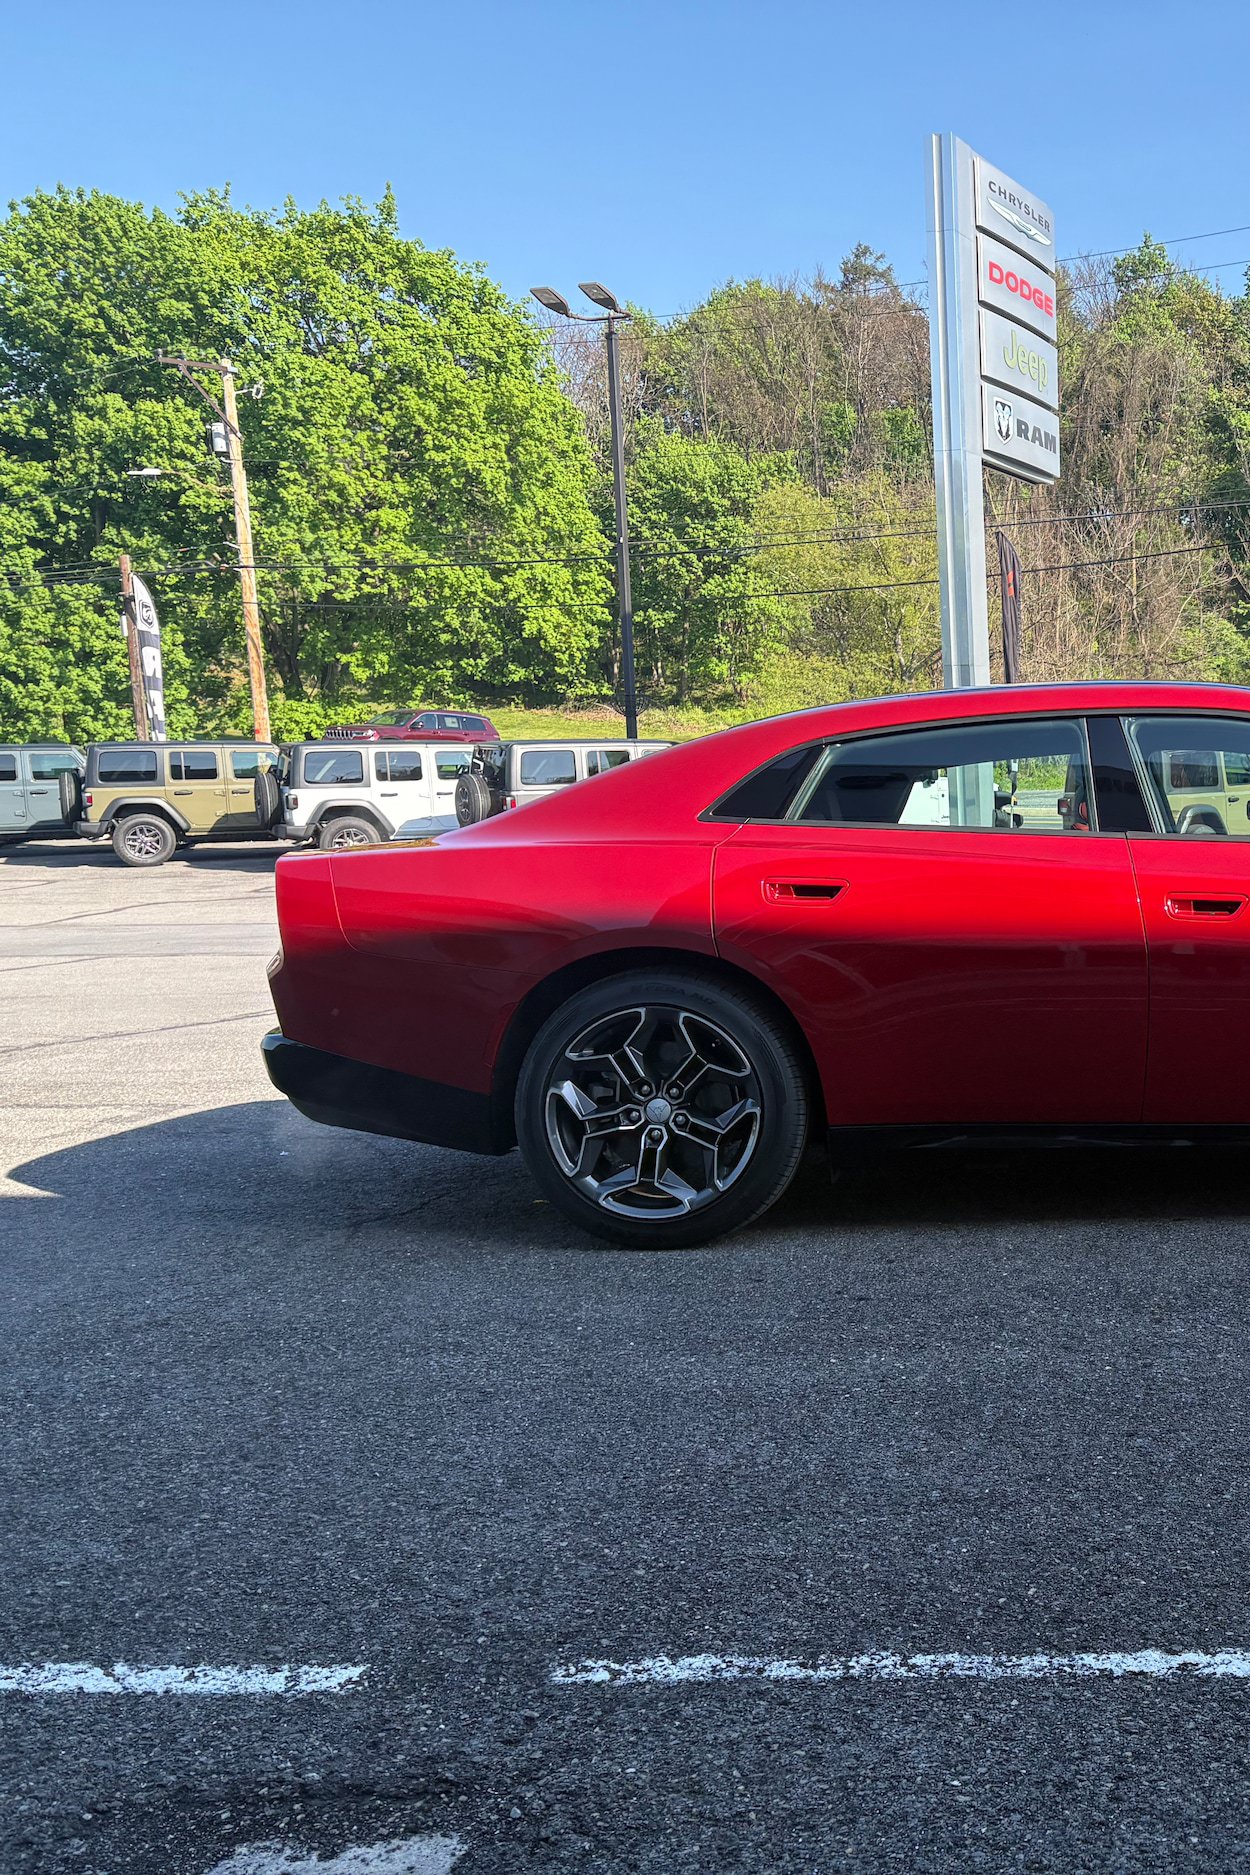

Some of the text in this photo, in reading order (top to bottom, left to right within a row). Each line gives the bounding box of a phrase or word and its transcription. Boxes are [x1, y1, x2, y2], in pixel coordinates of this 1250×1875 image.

[988, 181, 1051, 232] CHRYSLER
[988, 261, 1053, 317] DODGE
[1003, 330, 1048, 391] Jeep
[1016, 419, 1057, 455] RAM
